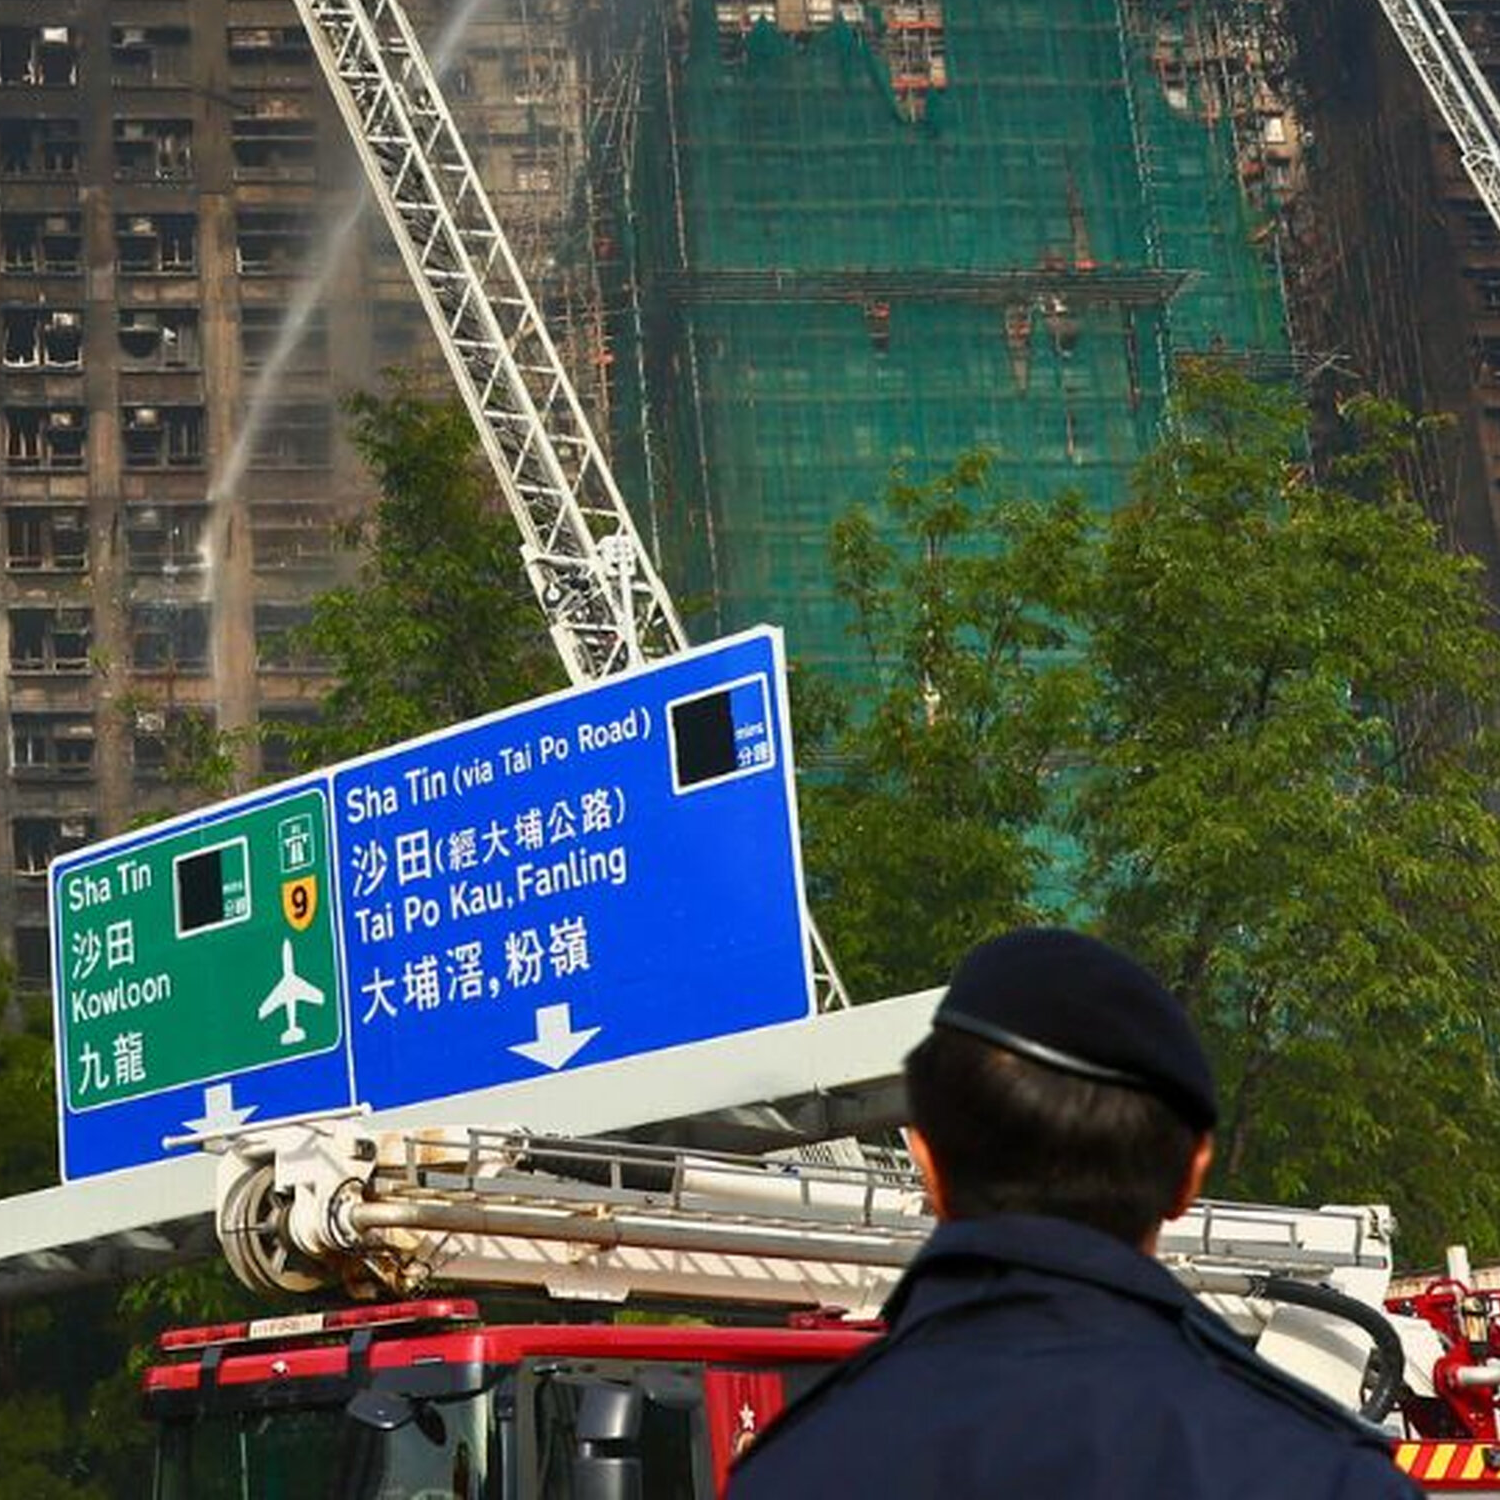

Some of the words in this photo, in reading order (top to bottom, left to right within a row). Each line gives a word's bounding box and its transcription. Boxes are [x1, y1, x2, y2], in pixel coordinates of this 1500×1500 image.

[346, 784, 398, 823] Sha
[405, 767, 447, 805] Tin
[453, 758, 493, 796] (via
[500, 743, 532, 776] Tai
[540, 735, 568, 765] Po
[578, 707, 650, 752] Road)
[68, 875, 111, 911] Sha
[117, 861, 151, 894] Tin
[292, 885, 308, 920] 9
[355, 902, 394, 944] Tai
[404, 896, 440, 933] Po
[516, 846, 627, 901] Fanling
[72, 919, 134, 979] 沙田
[71, 973, 171, 1023] Kowloon
[78, 1032, 146, 1094] 九龍
